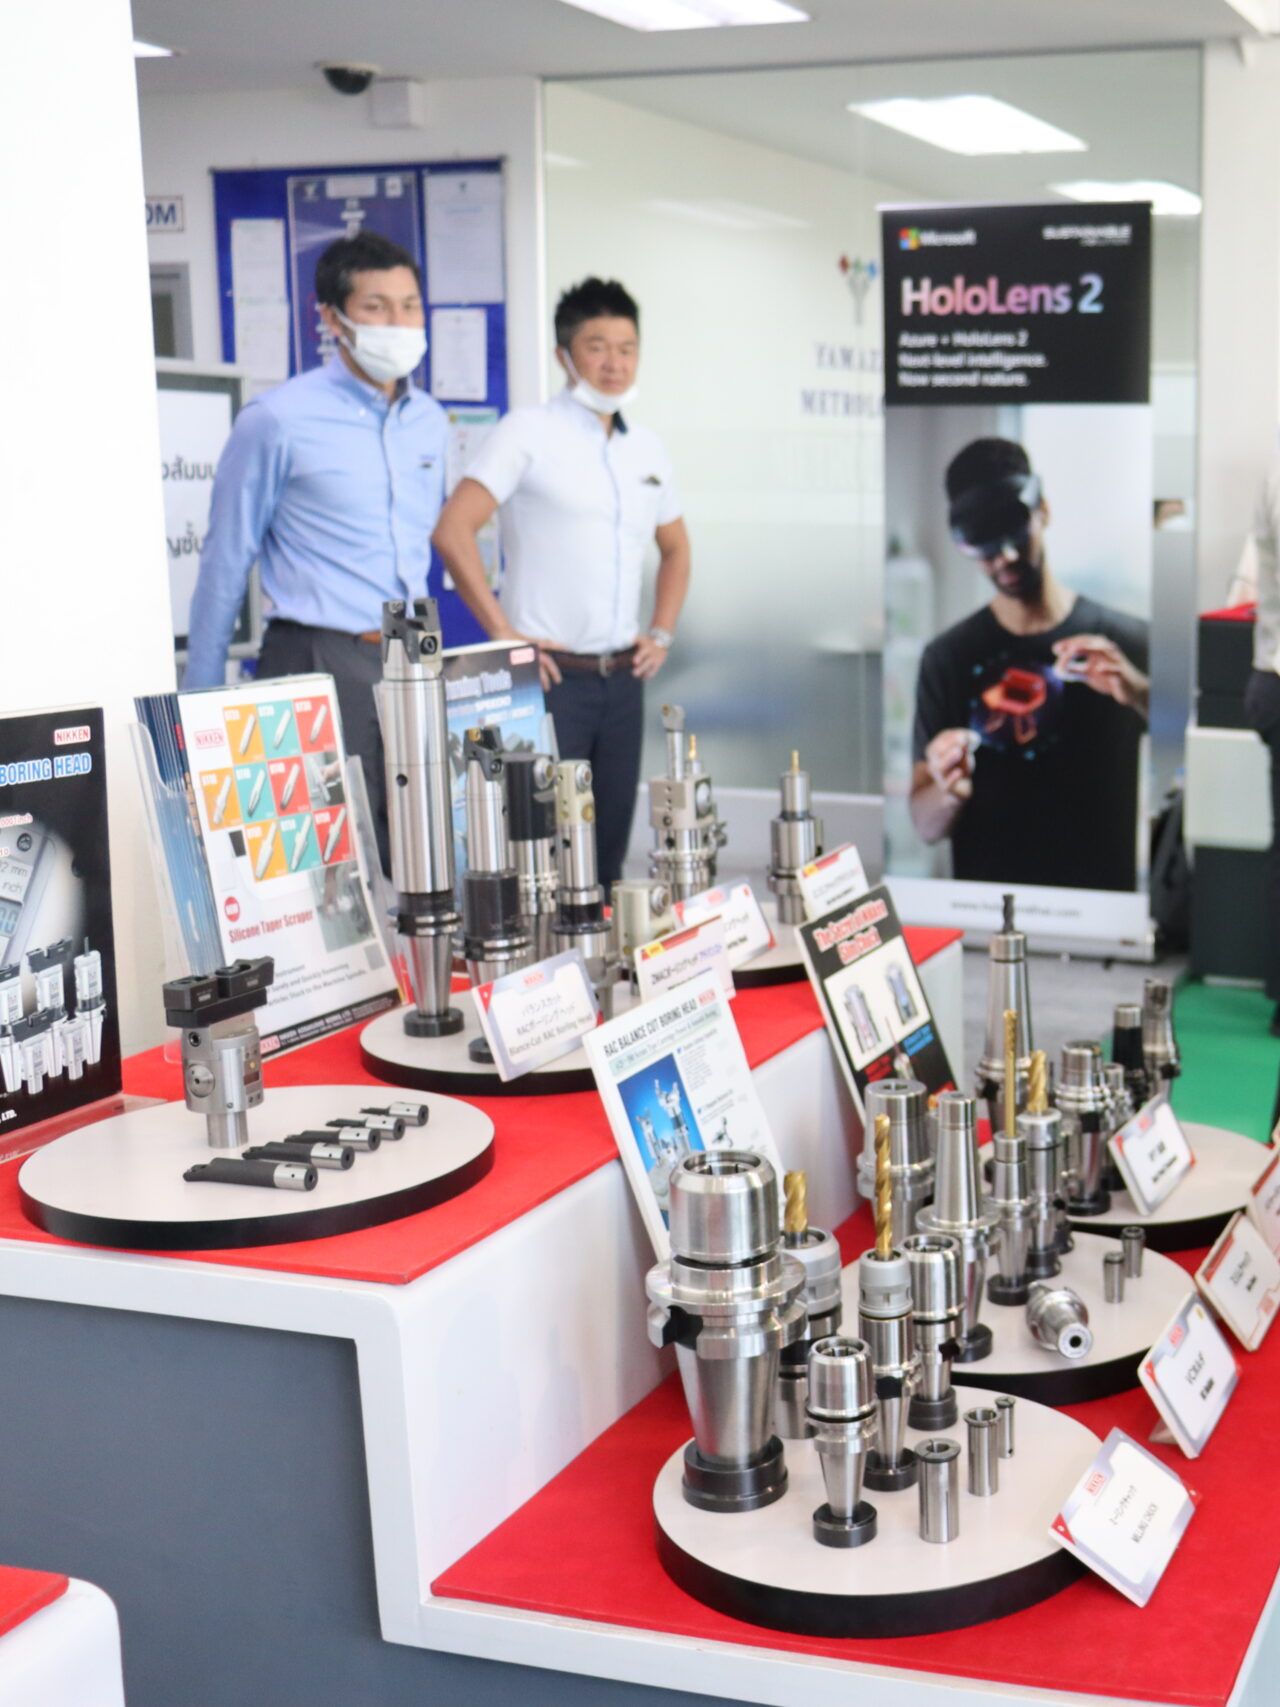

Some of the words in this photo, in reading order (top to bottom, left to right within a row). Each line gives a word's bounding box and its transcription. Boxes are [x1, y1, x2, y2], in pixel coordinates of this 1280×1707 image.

[901, 275, 1073, 316] HoloLens
[1077, 272, 1104, 314] 2
[898, 331, 938, 348] Azure
[952, 330, 1016, 347] HoloLens
[1017, 329, 1029, 347] 2
[56, 729, 89, 743] NIKKEN
[0, 758, 52, 786] BORING
[53, 753, 92, 778] HEAD
[229, 924, 261, 944] Silicone
[260, 918, 282, 934] Taper
[284, 910, 314, 927] Scraper
